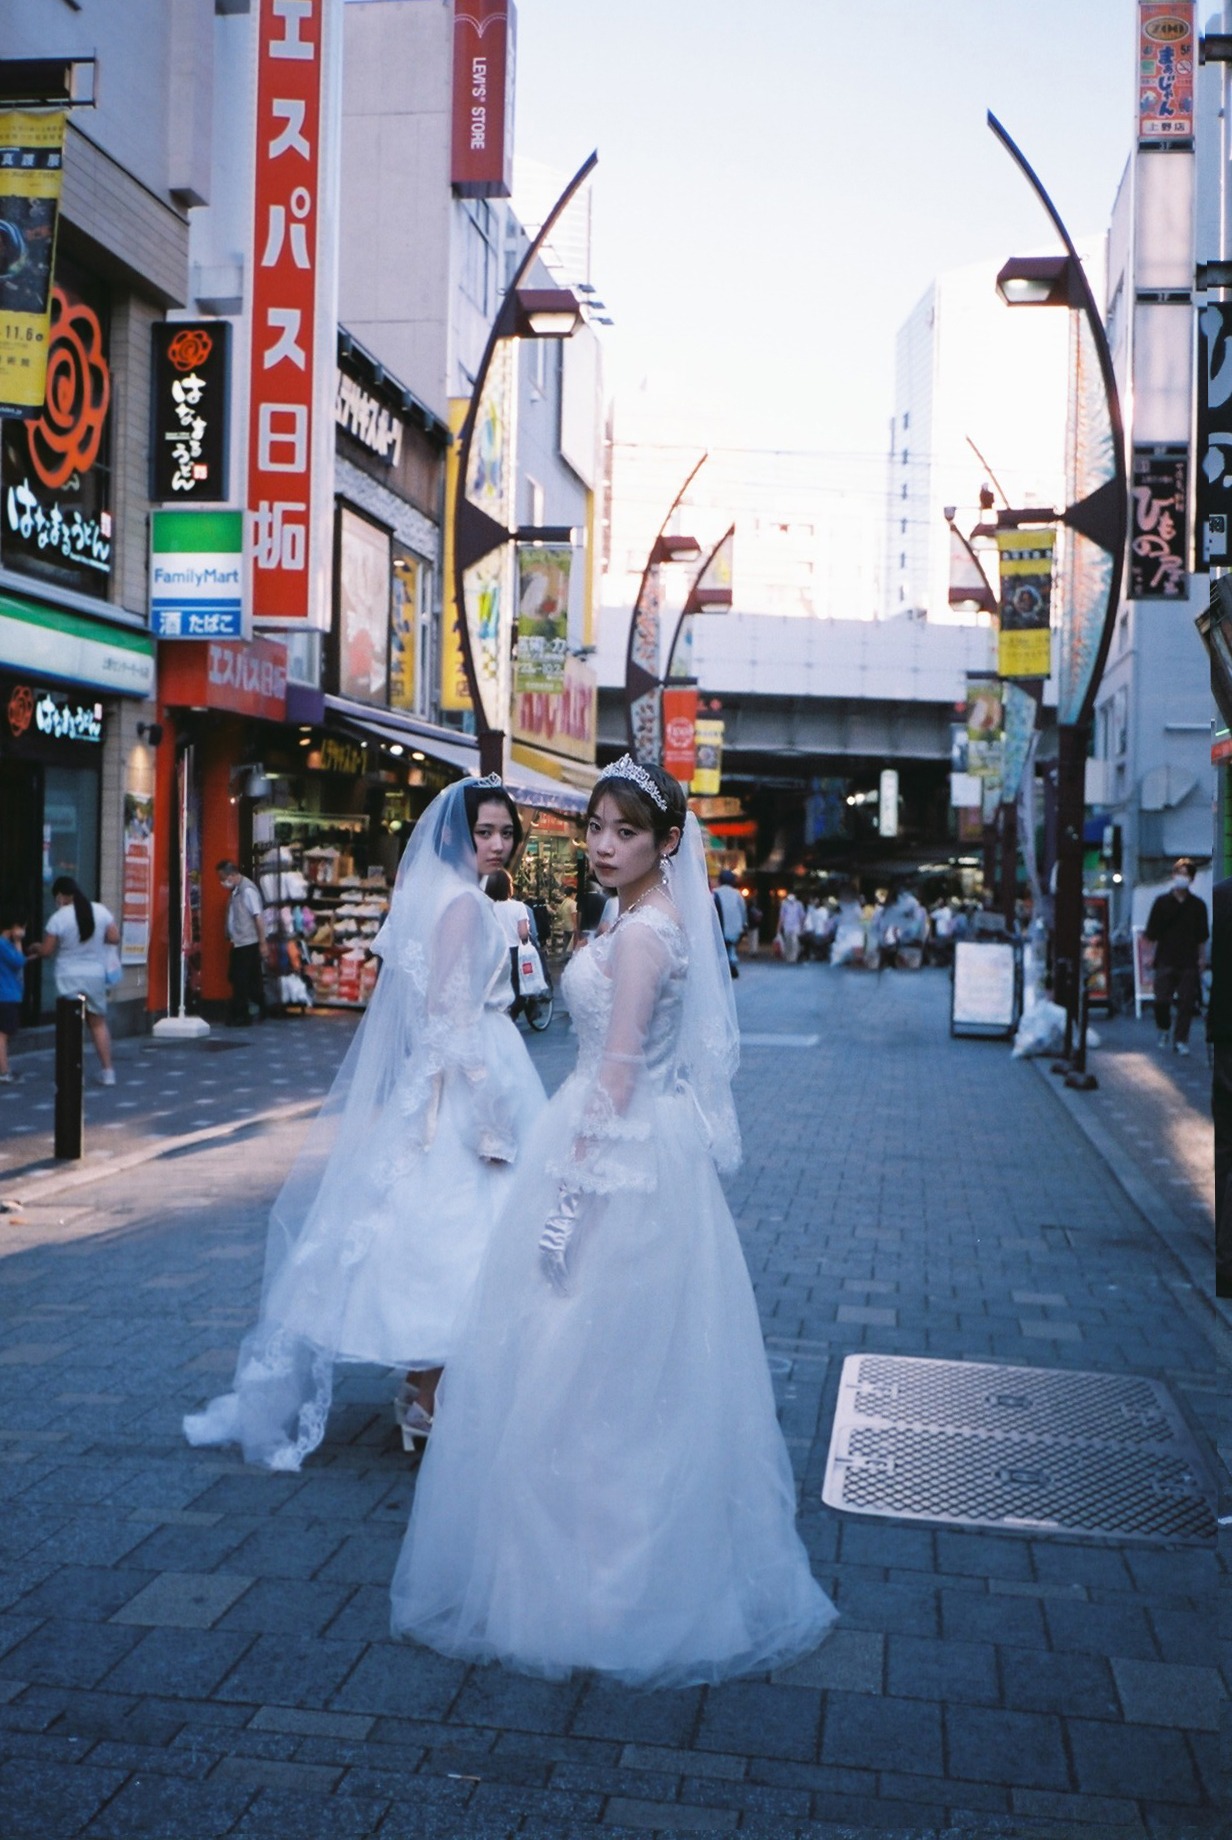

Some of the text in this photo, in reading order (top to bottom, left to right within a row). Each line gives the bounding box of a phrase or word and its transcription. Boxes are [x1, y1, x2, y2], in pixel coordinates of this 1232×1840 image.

[470, 106, 486, 150] STORE
[7, 477, 110, 561] はなまるうどん
[154, 568, 239, 586] FamilyMart
[159, 611, 234, 635] 酒 たばこ
